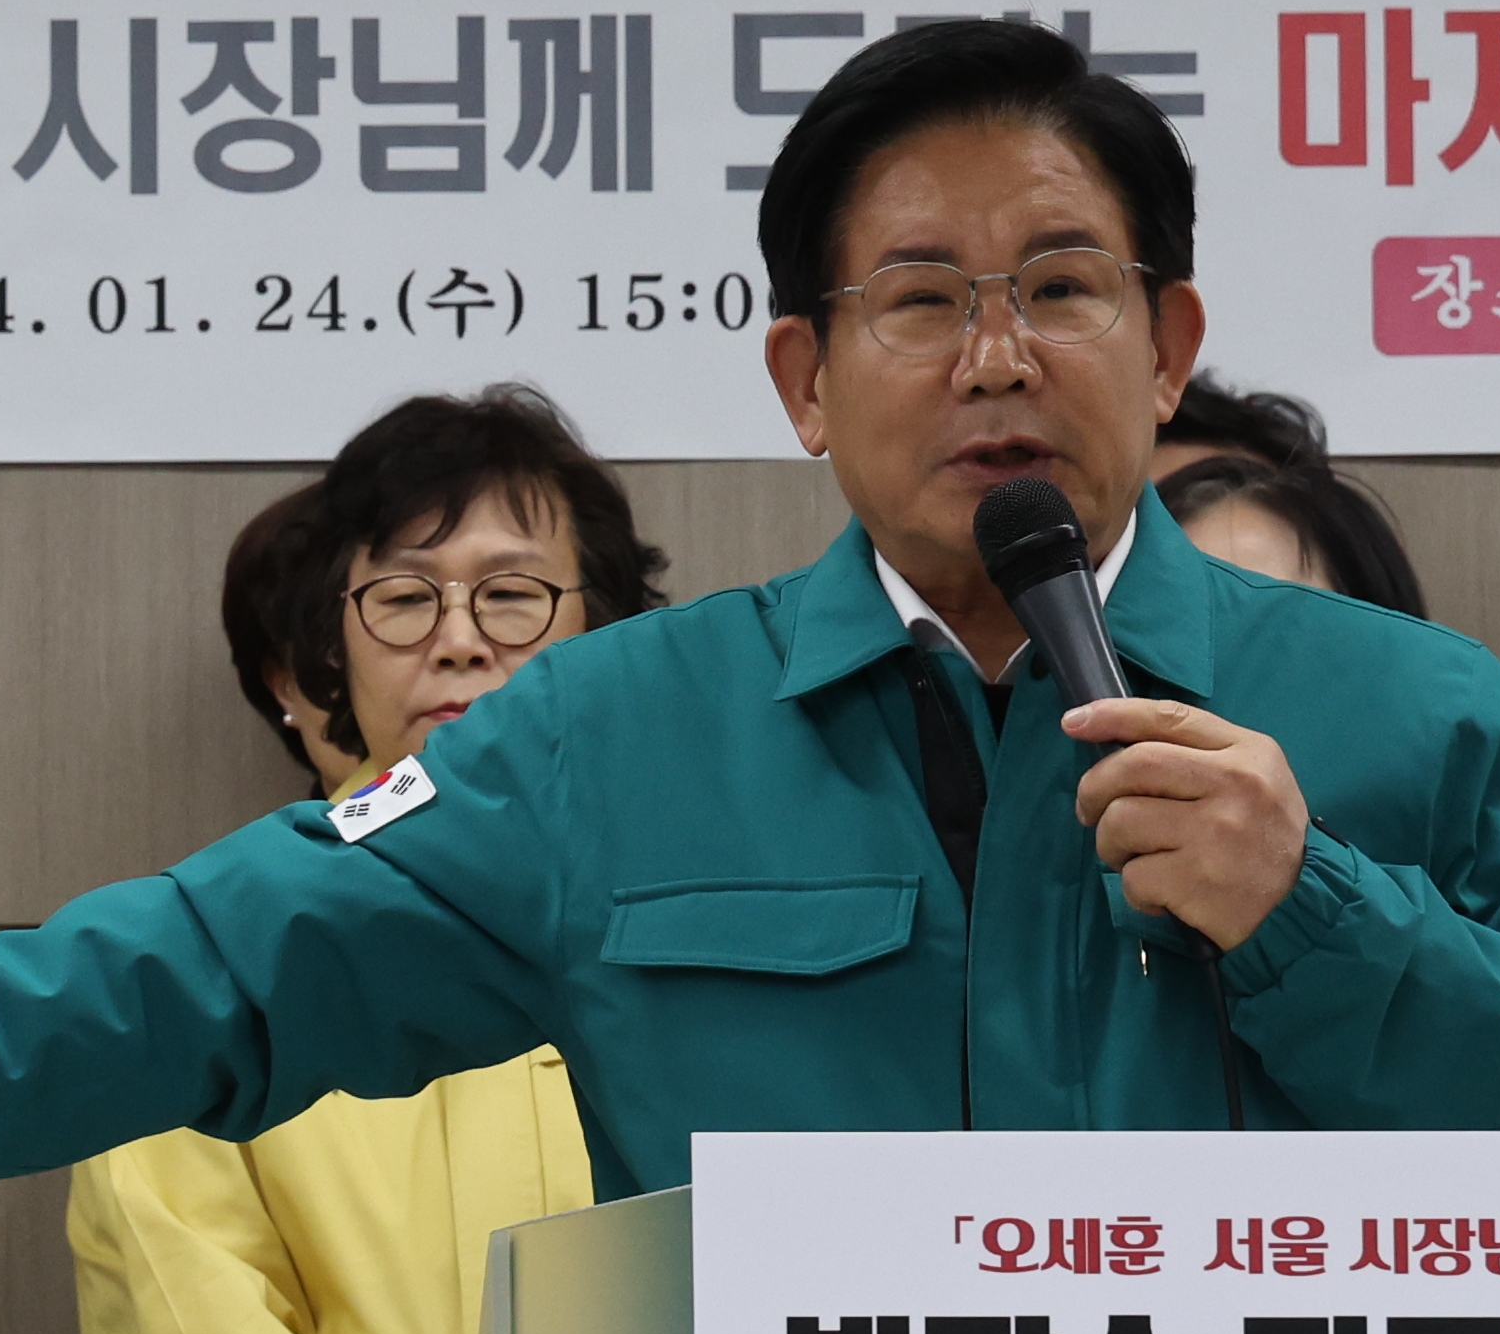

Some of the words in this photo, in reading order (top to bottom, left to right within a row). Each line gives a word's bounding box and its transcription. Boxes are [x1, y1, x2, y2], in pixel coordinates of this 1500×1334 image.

[13, 14, 653, 194] 시장님께
[88, 276, 211, 334] 01.
[577, 271, 776, 331] 15:0
[1204, 1216, 1329, 1276] 서울
